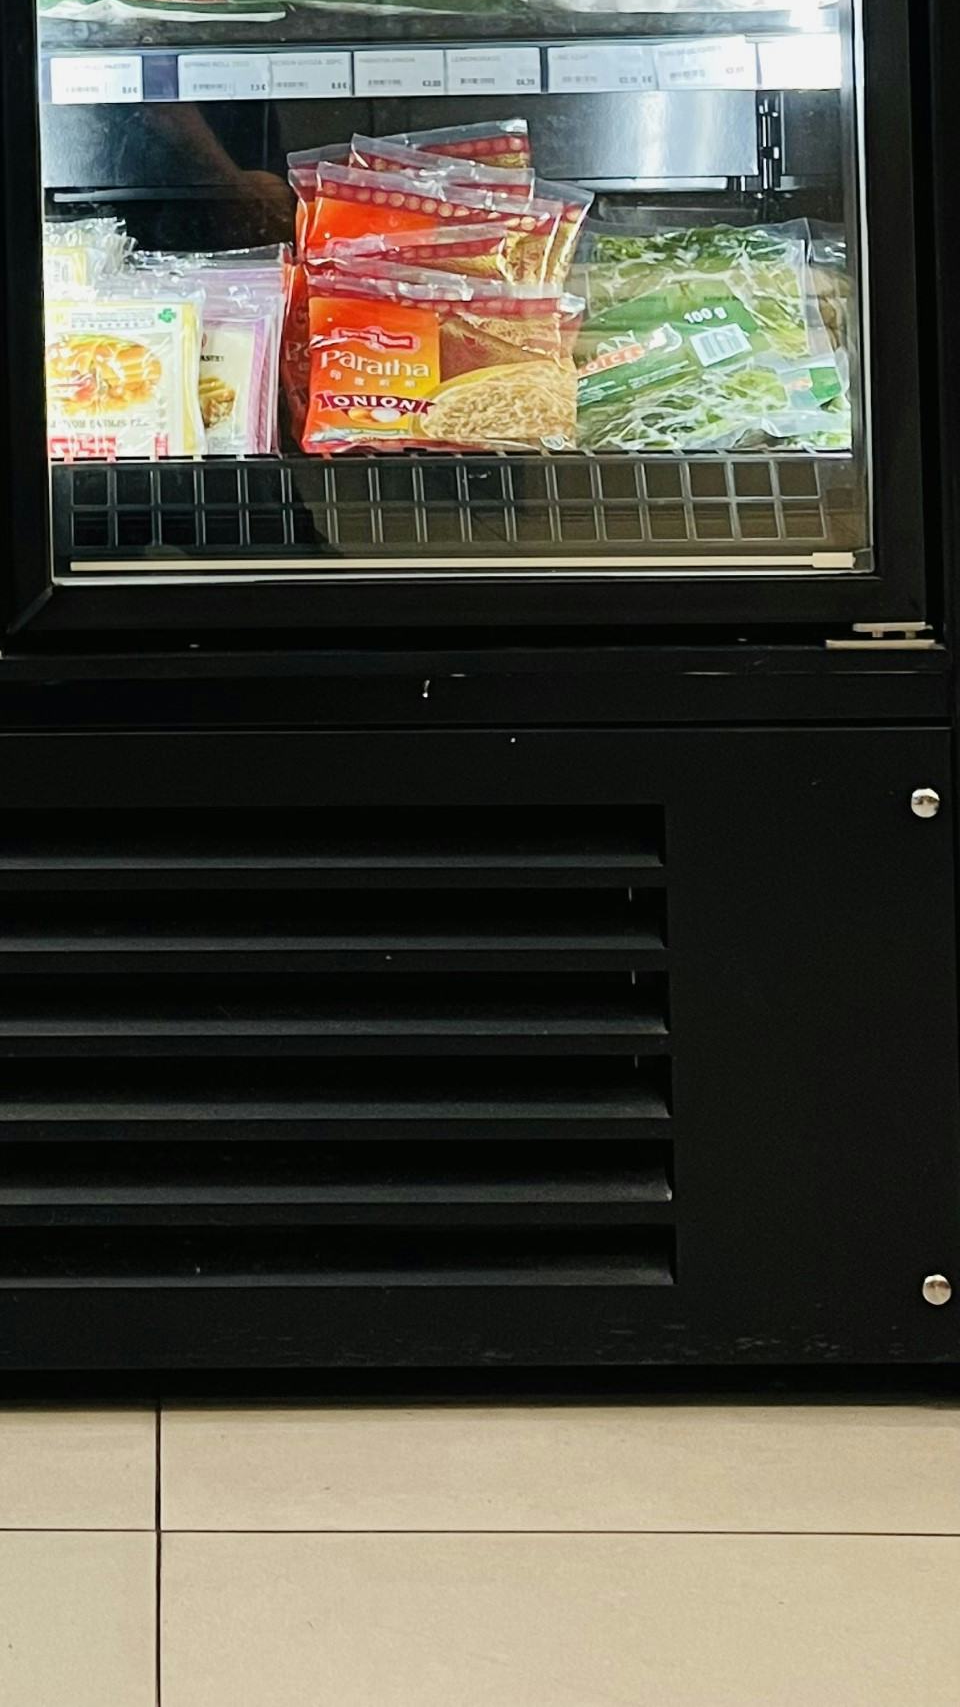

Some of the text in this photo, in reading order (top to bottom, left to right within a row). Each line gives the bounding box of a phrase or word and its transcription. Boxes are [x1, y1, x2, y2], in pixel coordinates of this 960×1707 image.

[683, 306, 727, 324] 100 g
[321, 349, 430, 377] Paratha
[333, 395, 417, 411] ONION
